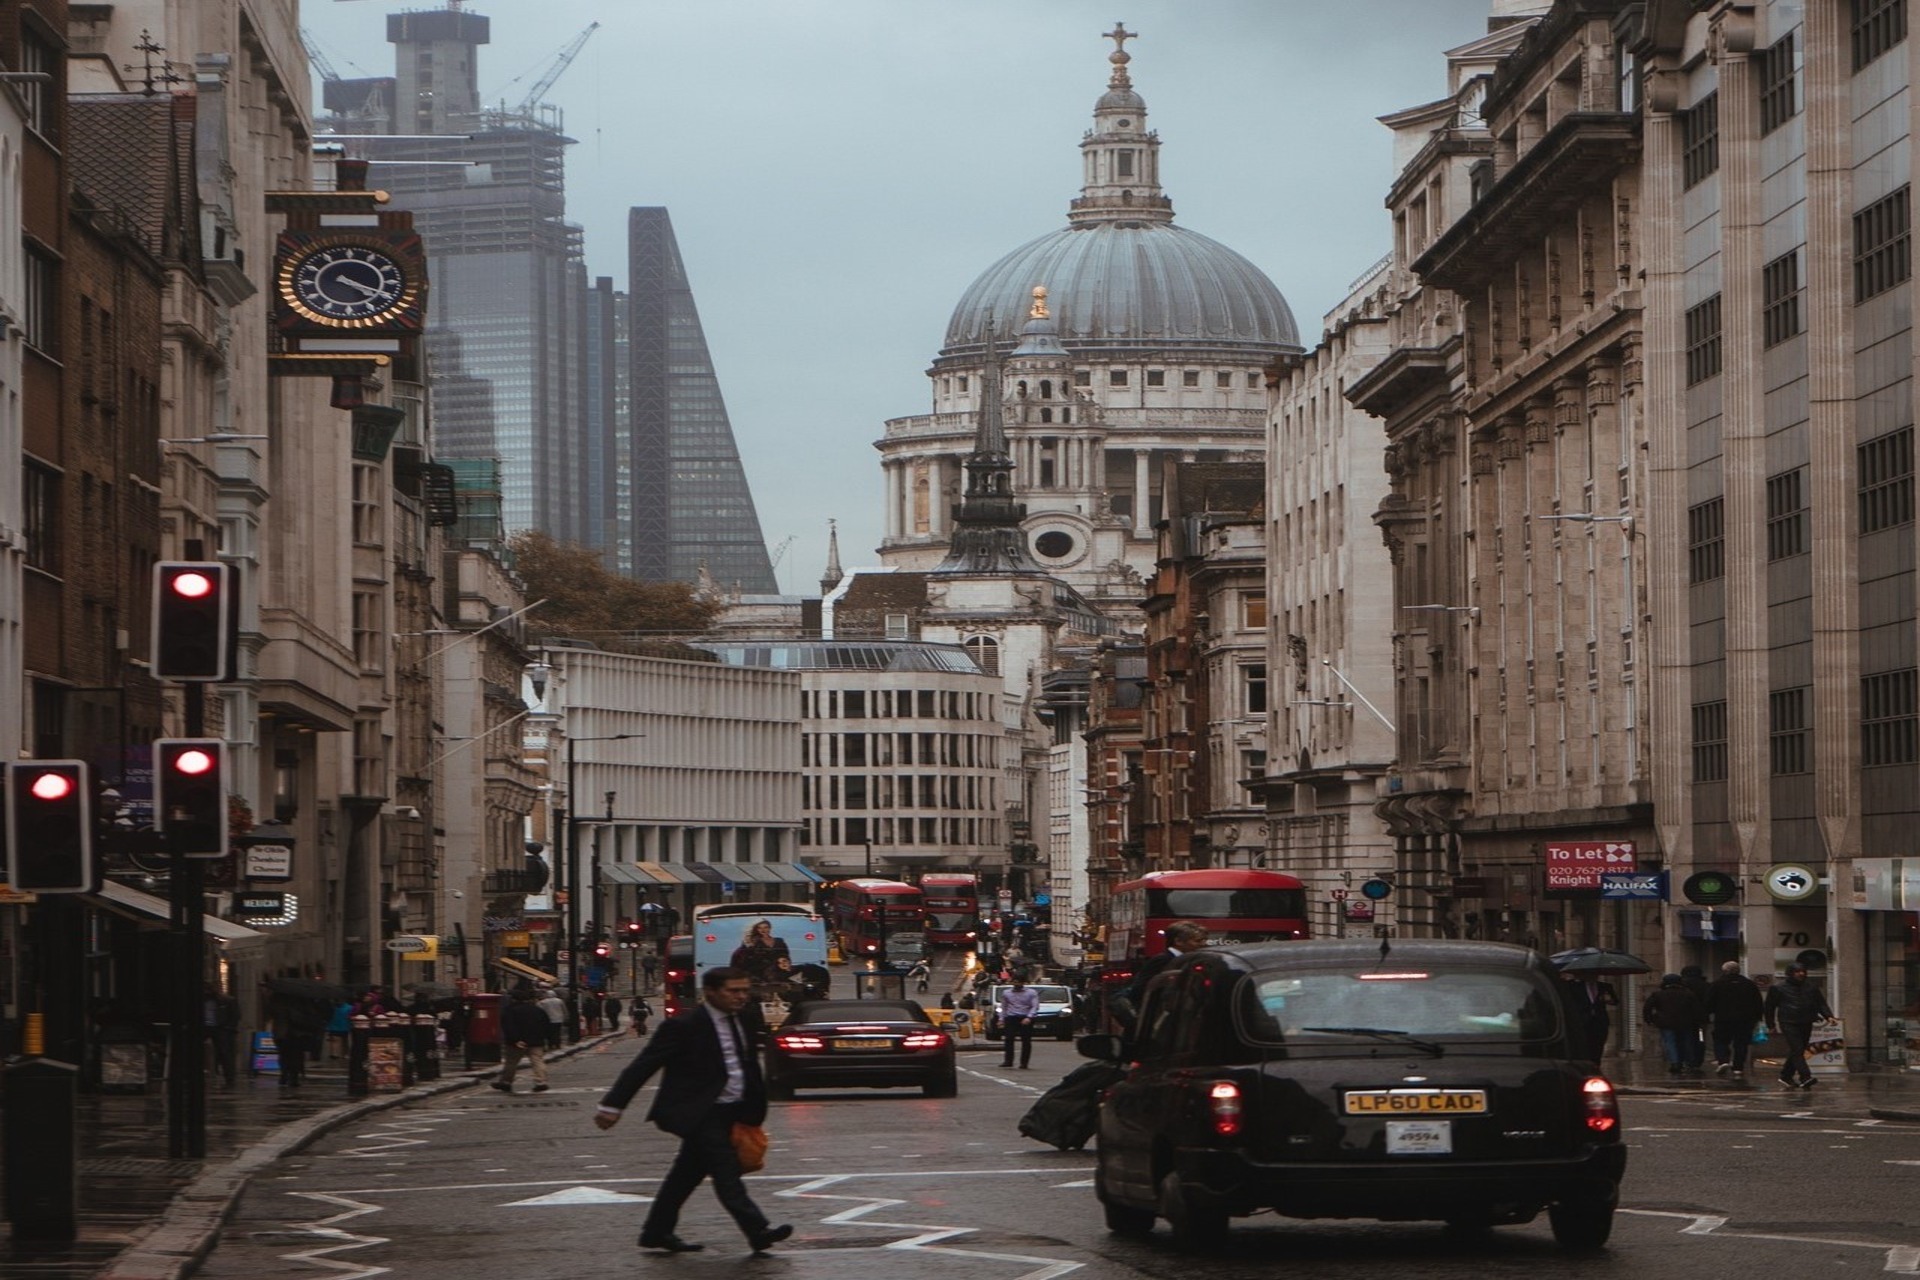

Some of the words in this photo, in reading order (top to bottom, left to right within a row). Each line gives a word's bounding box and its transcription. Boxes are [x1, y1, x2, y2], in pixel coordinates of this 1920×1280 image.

[1549, 848, 1570, 859] To
[1575, 848, 1603, 859] Let
[1549, 866, 1573, 875] 020
[1576, 866, 1604, 875] 7629
[1550, 875, 1592, 887] Knight
[1603, 882, 1657, 890] HALIFAX
[1778, 931, 1810, 947] 70
[1358, 1095, 1420, 1110] LP60
[1398, 1131, 1439, 1141] 49594
